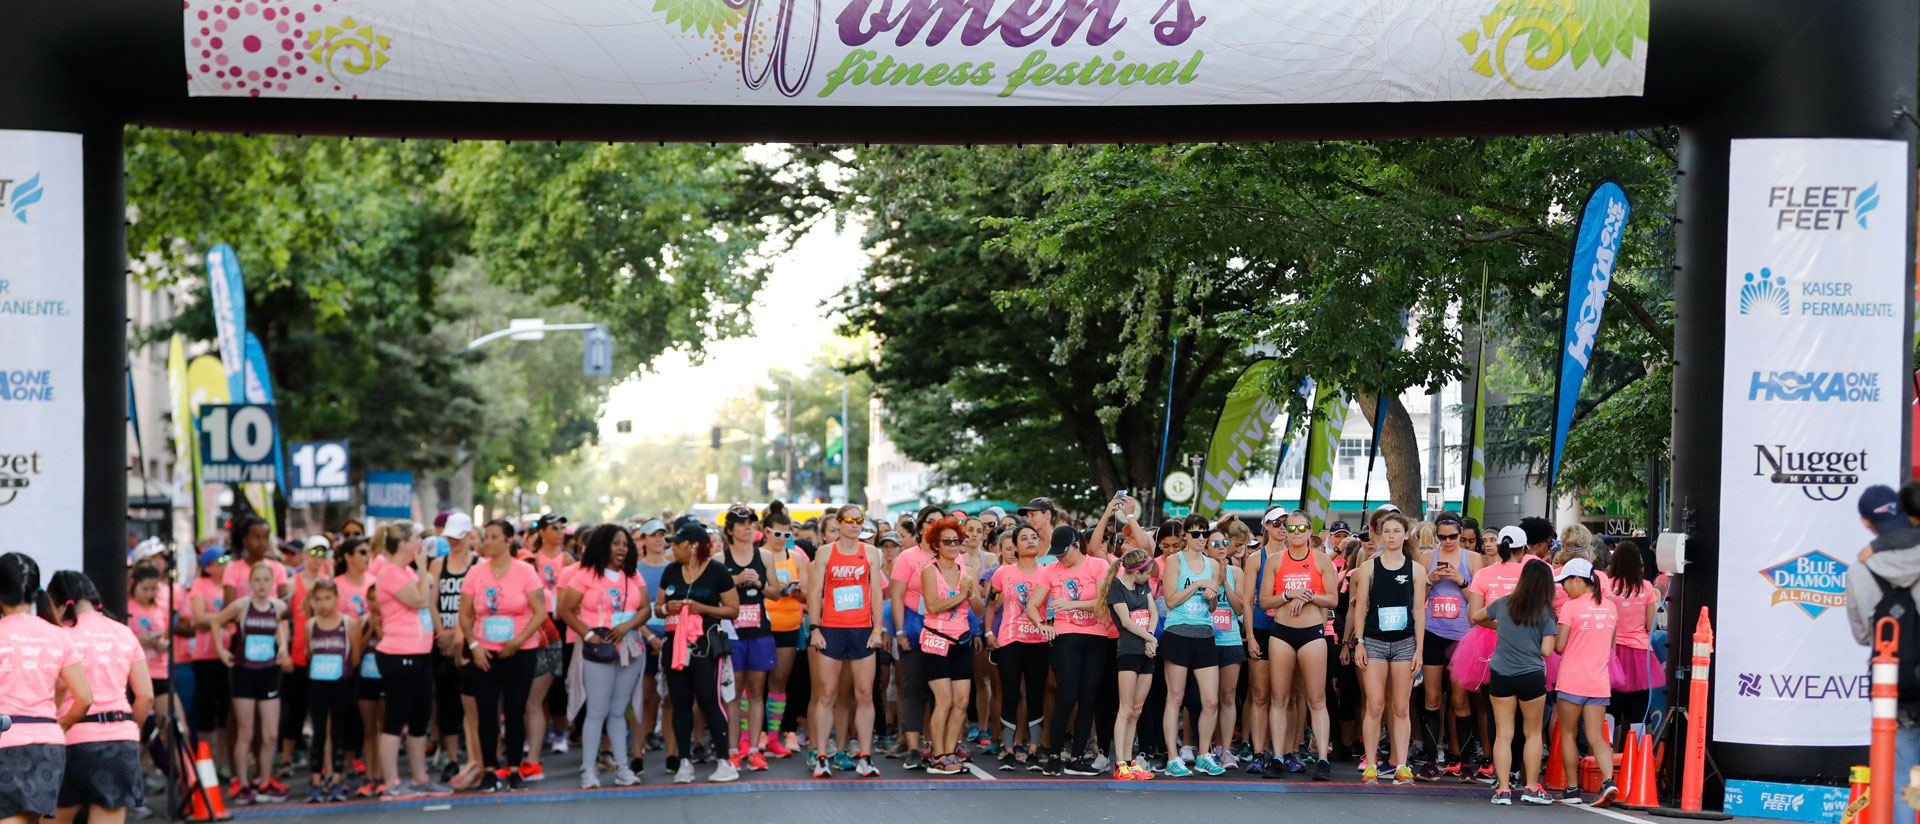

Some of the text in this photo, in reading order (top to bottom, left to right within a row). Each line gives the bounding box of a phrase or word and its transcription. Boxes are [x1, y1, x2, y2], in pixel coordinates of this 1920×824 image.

[817, 49, 1204, 98] fitness festival
[1768, 186, 1857, 208] FLEET
[1777, 209, 1849, 231] FEET
[1802, 282, 1852, 296] KAISER
[1567, 246, 1614, 371] HOKA
[1802, 302, 1893, 317] PERMANENTE
[9, 370, 50, 385] ONE
[13, 386, 53, 401] ONE
[1748, 371, 1879, 402] HOKA ONE
[1848, 388, 1880, 402] ONE
[201, 406, 274, 462] 10
[292, 443, 347, 488] 12
[1753, 444, 1868, 476] Nugget
[202, 464, 275, 482] MIN/MI
[1789, 475, 1857, 483] MARKET
[1615, 499, 1635, 515] THE
[1608, 520, 1638, 535] SALA
[1796, 557, 1836, 575] BLUE
[1285, 581, 1307, 590] 4821
[837, 593, 859, 604] 2407
[1434, 603, 1456, 612] 5168
[1384, 615, 1401, 624] 287
[1018, 624, 1039, 633] 4564
[924, 639, 946, 649] 4622
[1760, 792, 1794, 803] FLEET
[1763, 801, 1791, 812] FEET
[1845, 796, 1869, 817] CAUTION
